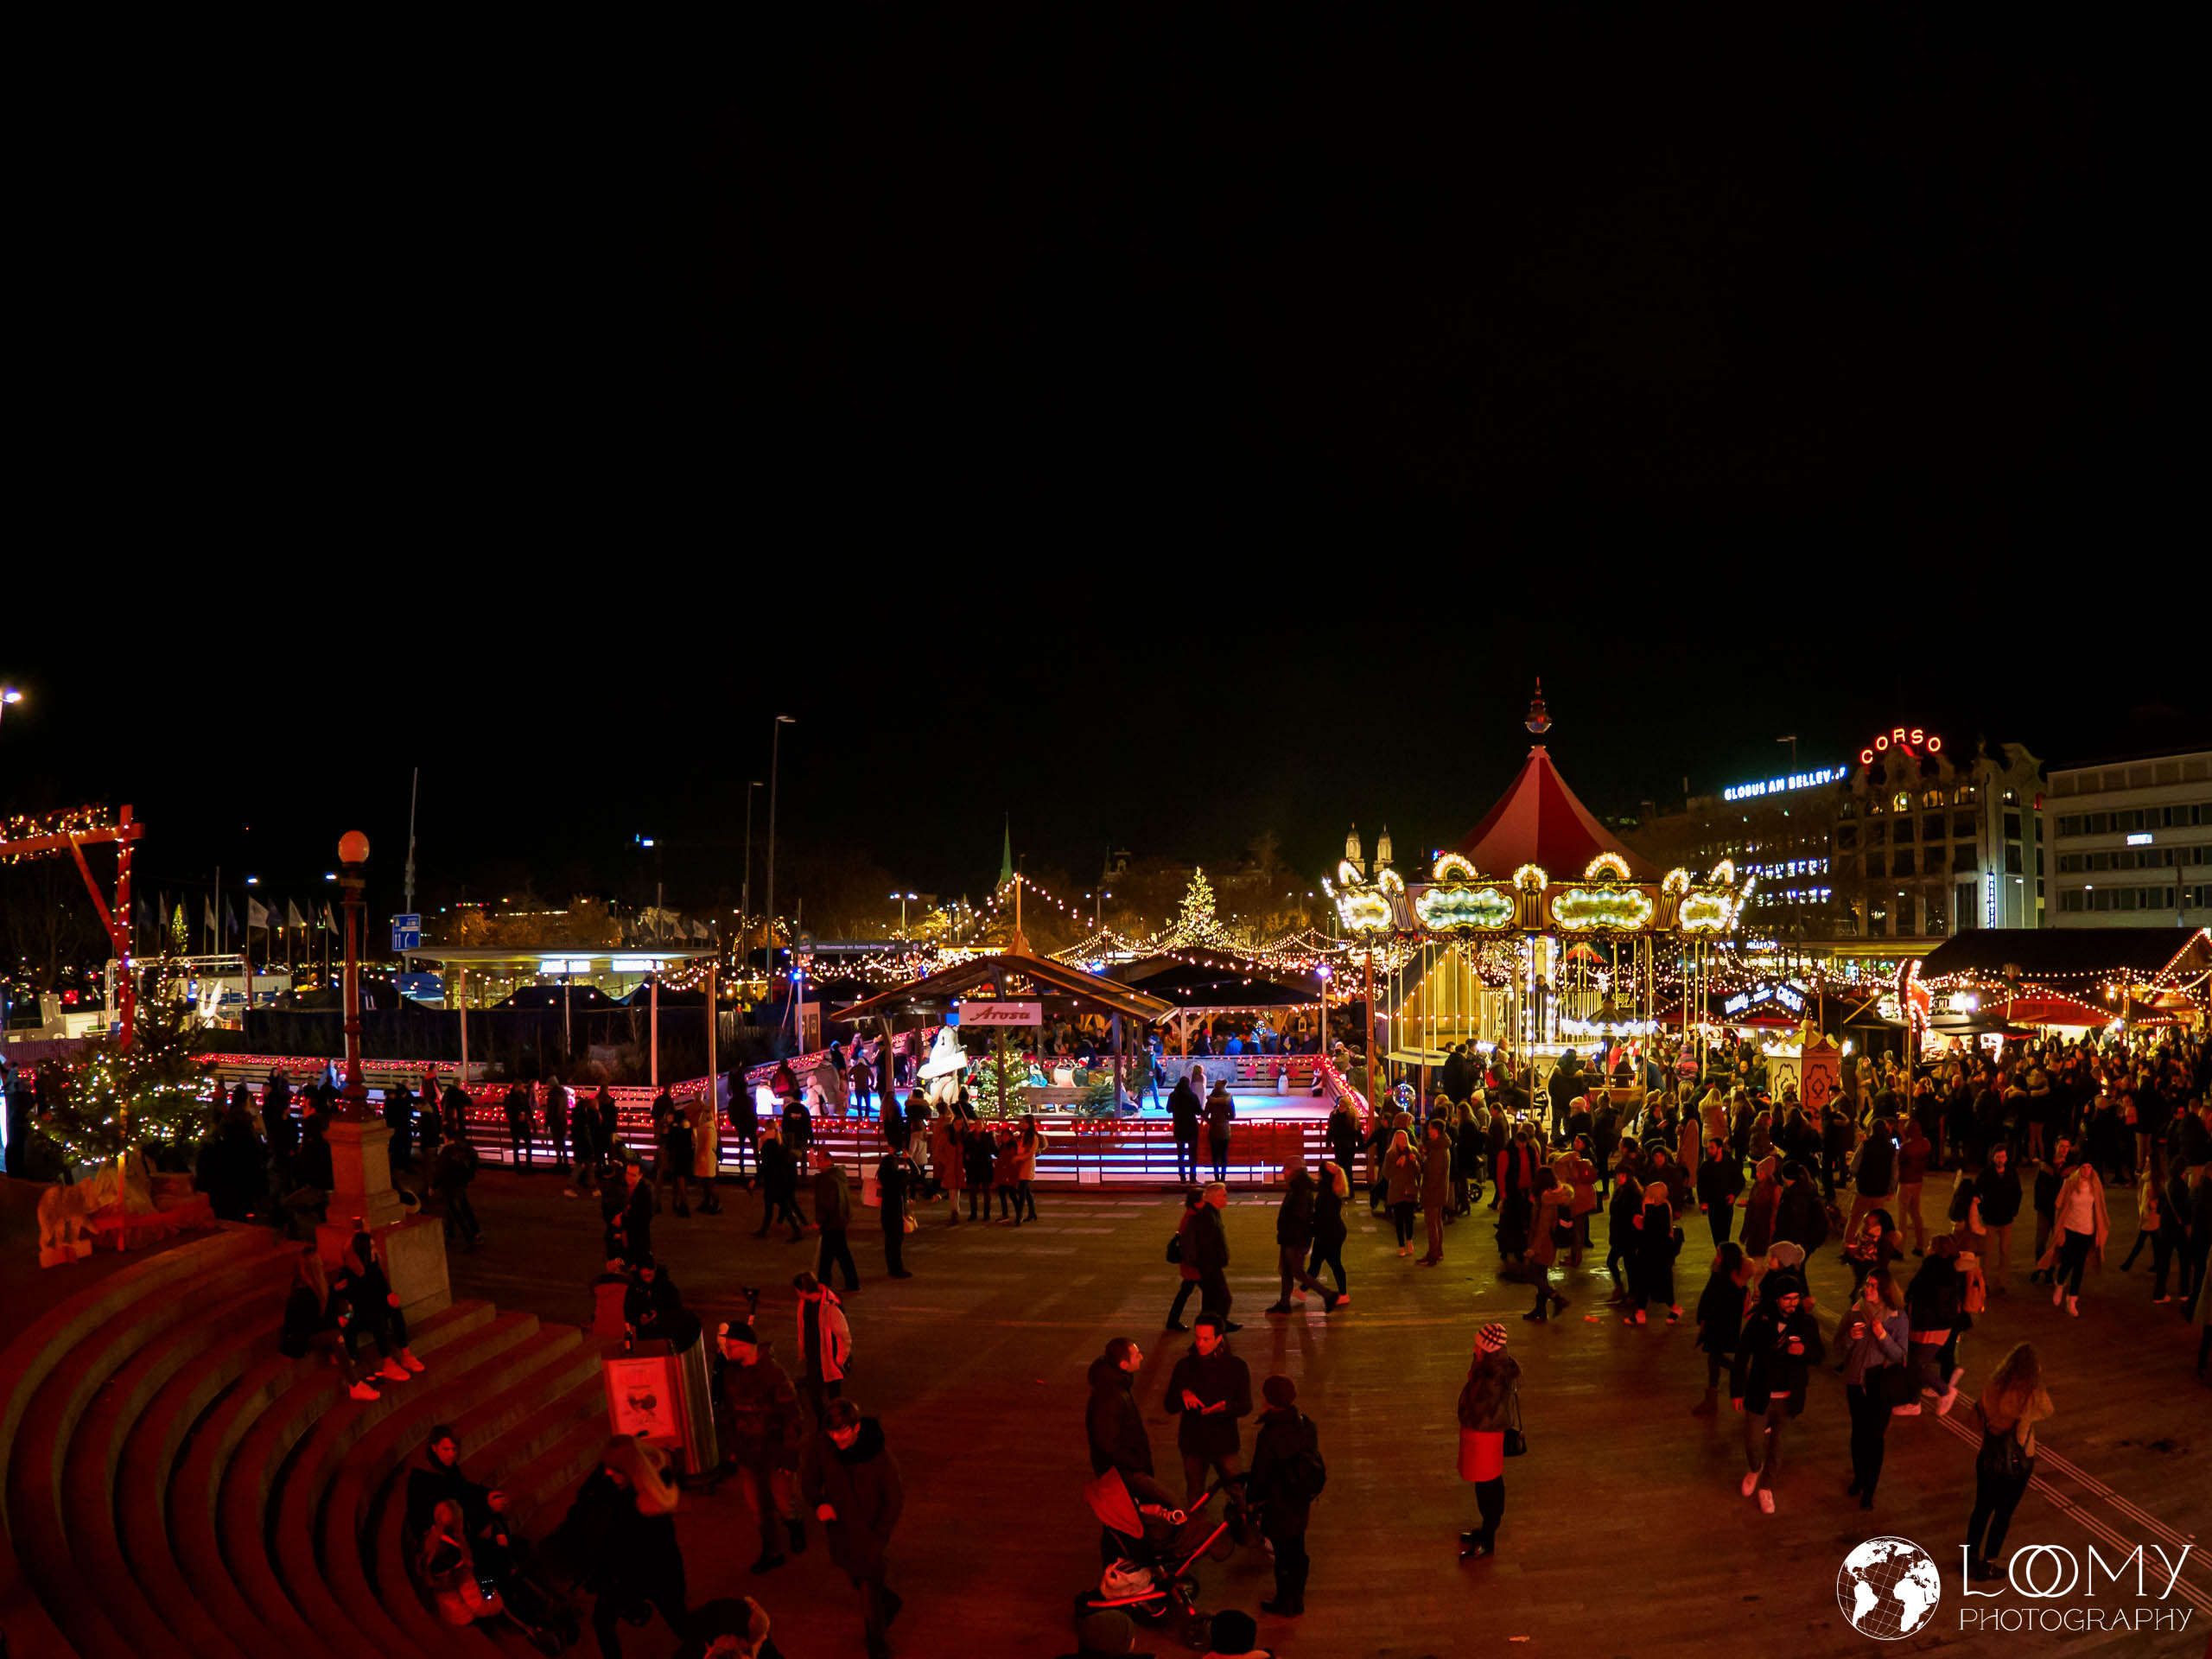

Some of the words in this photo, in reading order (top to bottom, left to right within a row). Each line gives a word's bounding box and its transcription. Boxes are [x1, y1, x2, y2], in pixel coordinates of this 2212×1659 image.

[1860, 728, 1942, 765] CORSO
[1724, 781, 1766, 801] GLOBUS
[1768, 778, 1785, 793] AM
[969, 1006, 1031, 1021] Arosa
